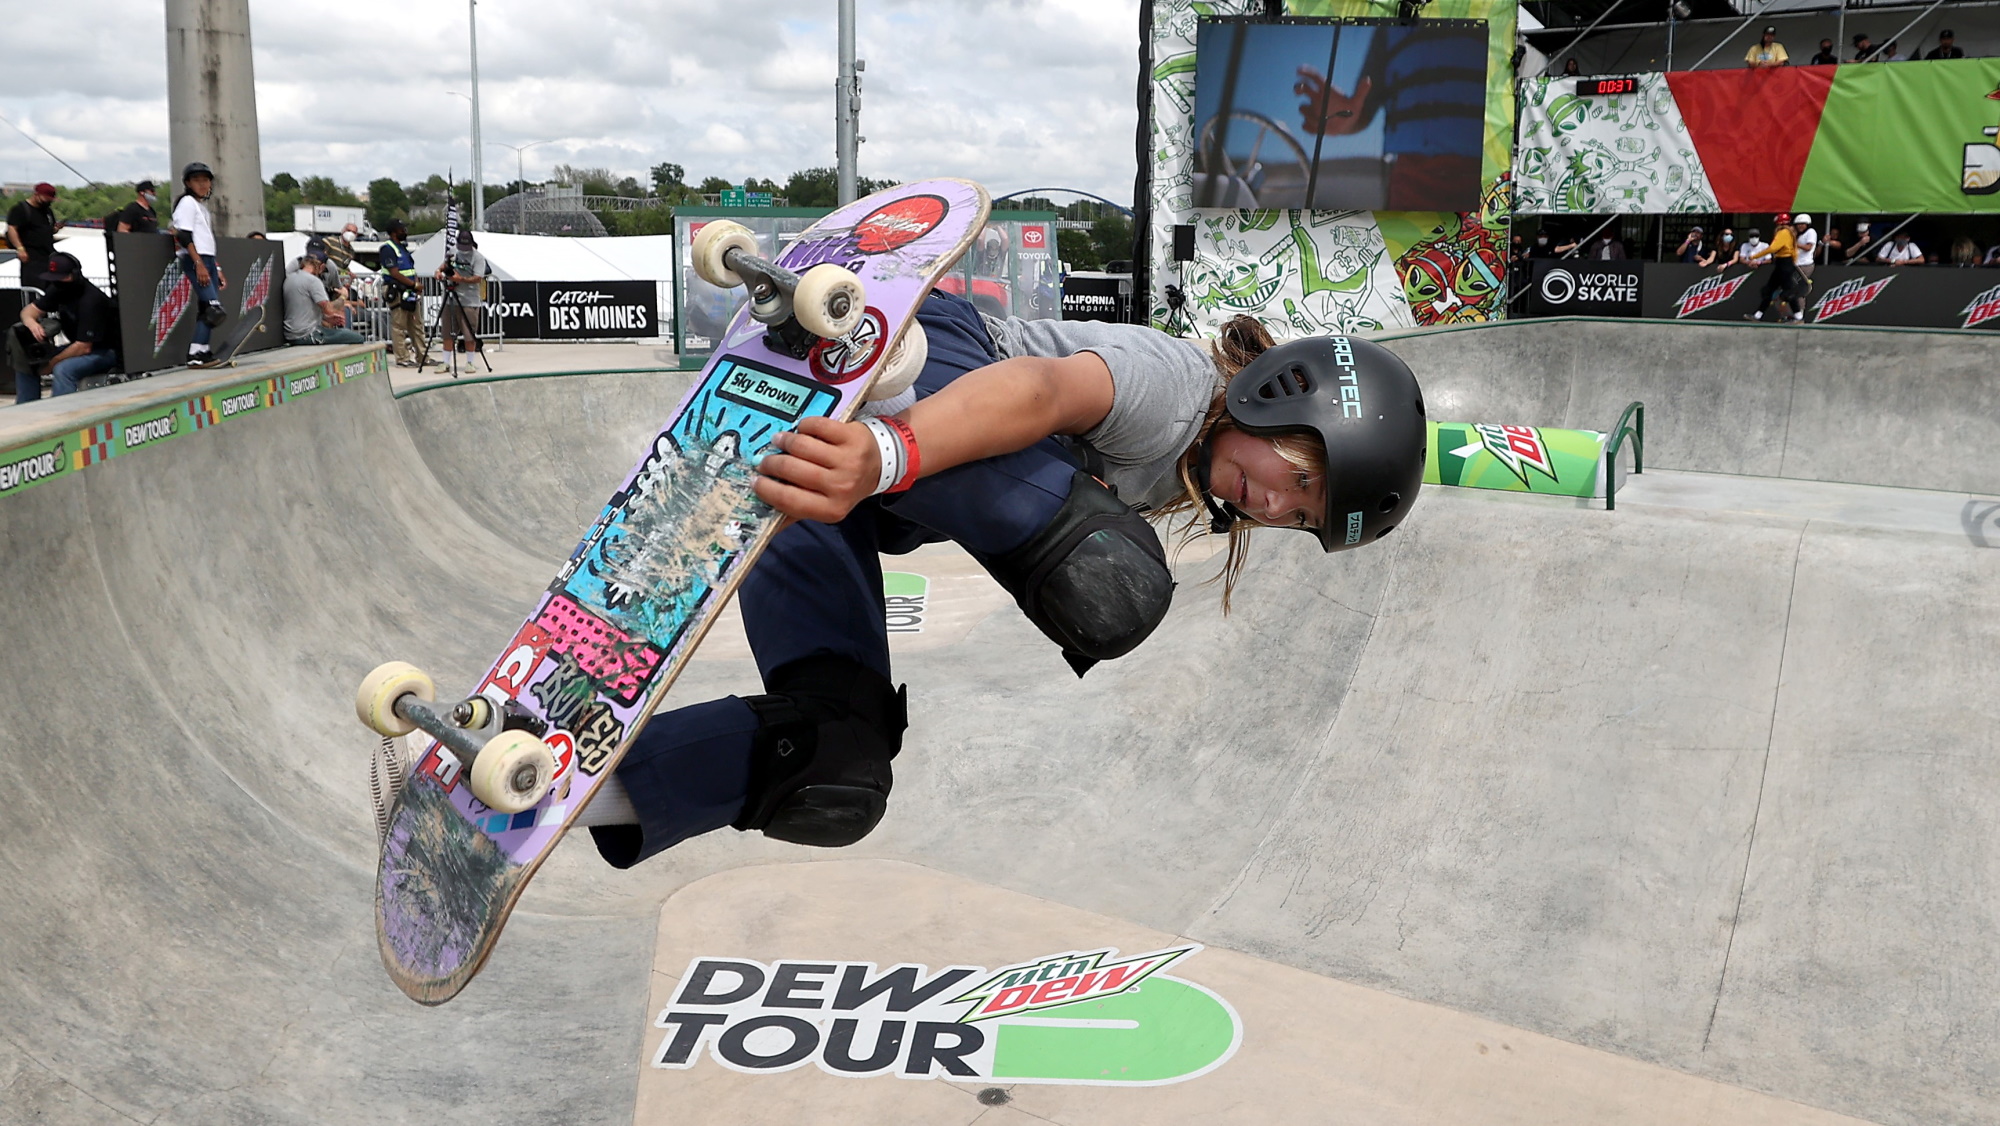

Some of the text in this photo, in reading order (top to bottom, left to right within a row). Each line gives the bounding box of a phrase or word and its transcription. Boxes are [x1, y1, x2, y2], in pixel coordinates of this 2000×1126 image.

[1598, 80, 1633, 94] 00:37
[1579, 273, 1638, 287] WORLD
[549, 290, 613, 304] CATCH
[1063, 295, 1115, 304] ALIFORNIA
[1578, 287, 1638, 302] SKATE
[484, 302, 534, 318] YOTA
[1062, 304, 1115, 313] kateparks
[549, 305, 647, 330] DES MOINES
[731, 372, 799, 407] Sky Brown
[676, 960, 978, 1012] DEW
[661, 1012, 986, 1077] TOUR
